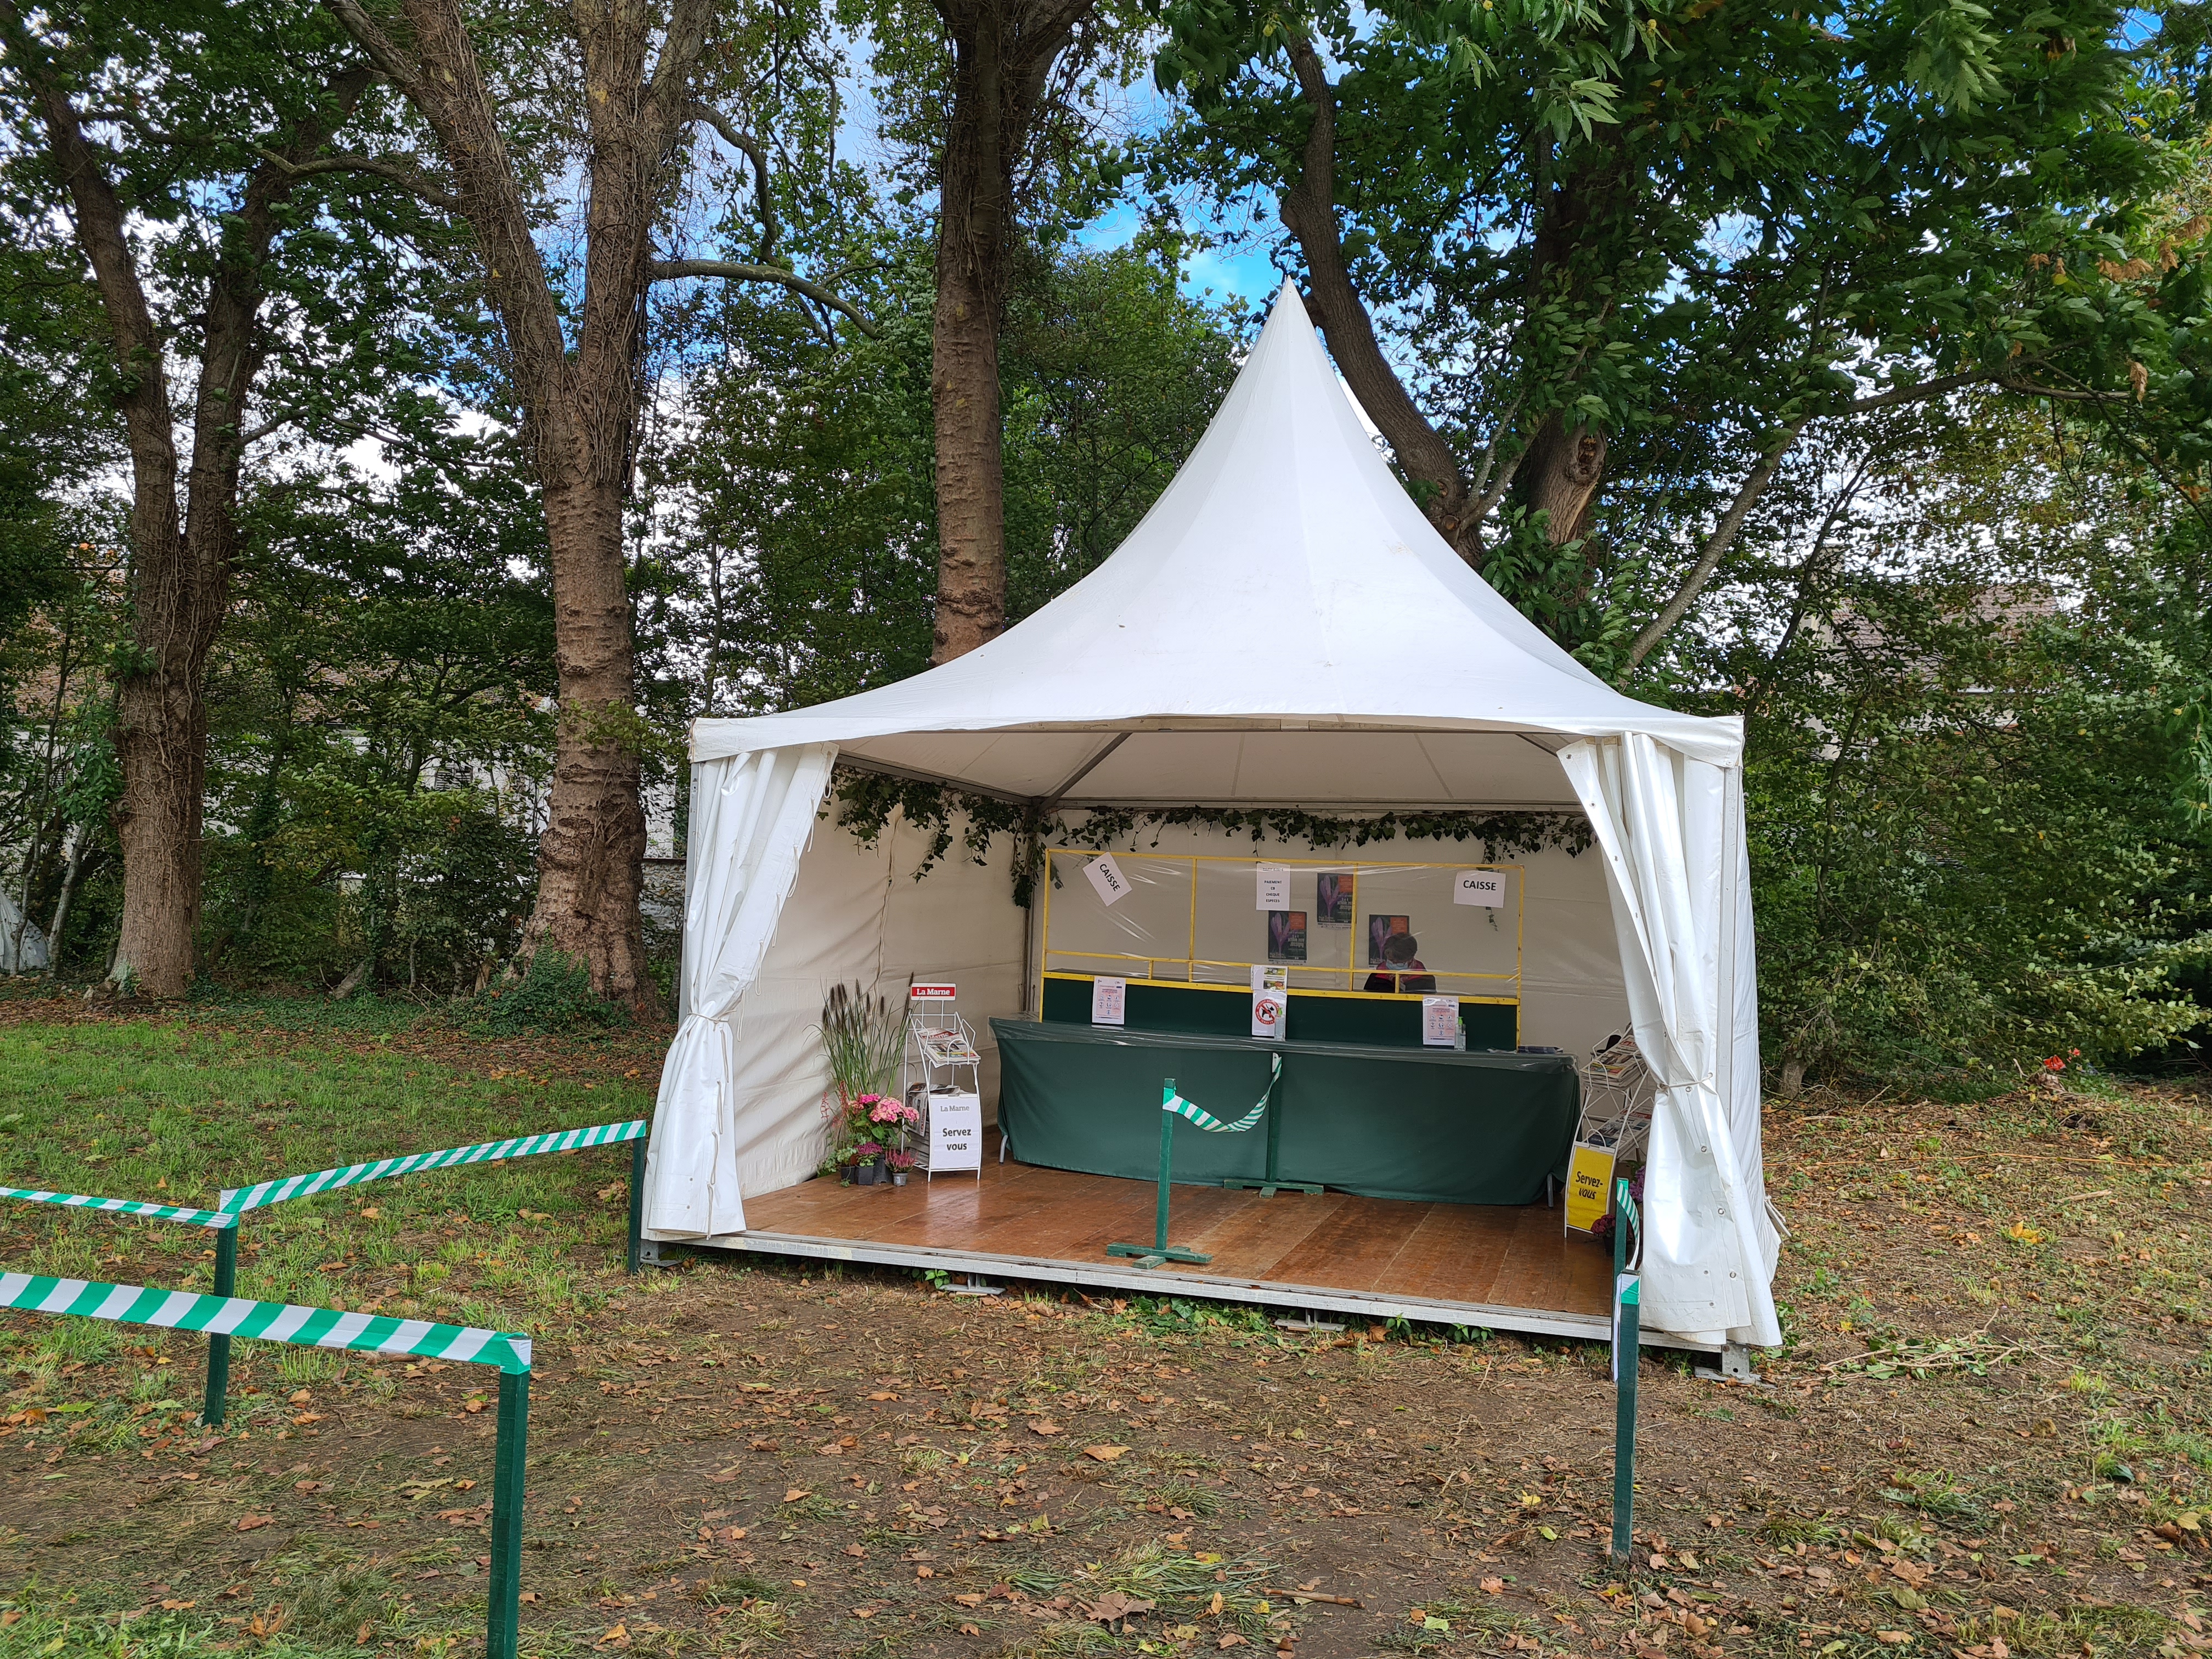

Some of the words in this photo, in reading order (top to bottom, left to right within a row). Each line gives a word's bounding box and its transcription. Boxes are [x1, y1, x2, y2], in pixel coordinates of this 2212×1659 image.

[1099, 864, 1120, 891] CAISSE
[1463, 880, 1497, 890] CAISSE
[943, 1128, 972, 1137] Servez
[1576, 1171, 1603, 1188] Servez-
[1578, 1187, 1597, 1200] vous
